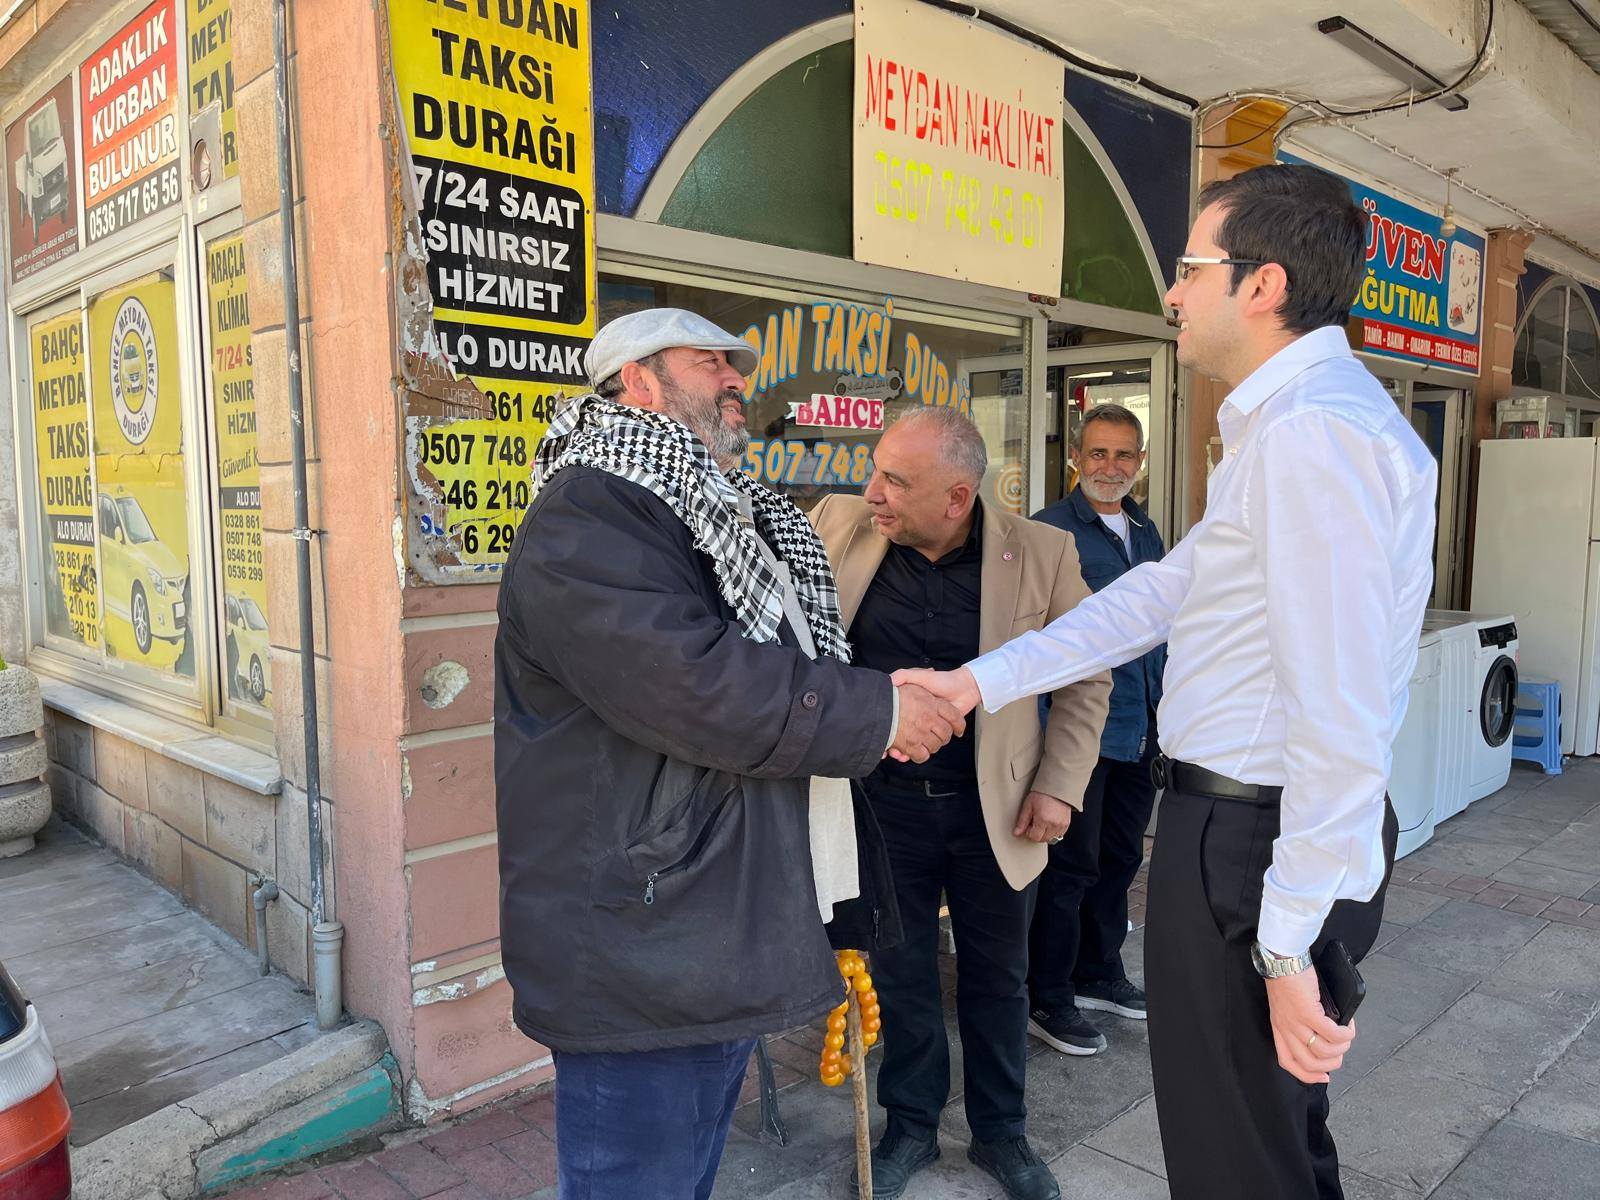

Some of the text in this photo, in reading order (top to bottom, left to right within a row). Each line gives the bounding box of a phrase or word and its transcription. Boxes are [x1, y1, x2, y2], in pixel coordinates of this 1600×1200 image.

[88, 8, 168, 101] ADAKLIK
[191, 9, 232, 65] MEY
[91, 64, 167, 148] KURBAN
[413, 92, 575, 174] DURAĞI
[866, 54, 1054, 176] MEYDAN NAKLİYAT
[89, 114, 176, 198] BULUNUR
[89, 166, 178, 241] 0536 717 65 56
[414, 165, 579, 229] 7/24 SAAT
[874, 149, 1044, 249] 0507 748 43 01
[426, 219, 570, 272] SINIRSIZ
[1363, 197, 1447, 284] ÜVEN
[438, 263, 563, 313] HİZMET
[488, 338, 583, 376] DURAK
[739, 305, 803, 403] DAN
[484, 435, 527, 466] 748
[812, 441, 870, 486] 748
[486, 480, 529, 510] 210
[57, 521, 93, 542] ALO DURAK
[226, 531, 245, 546] 0507
